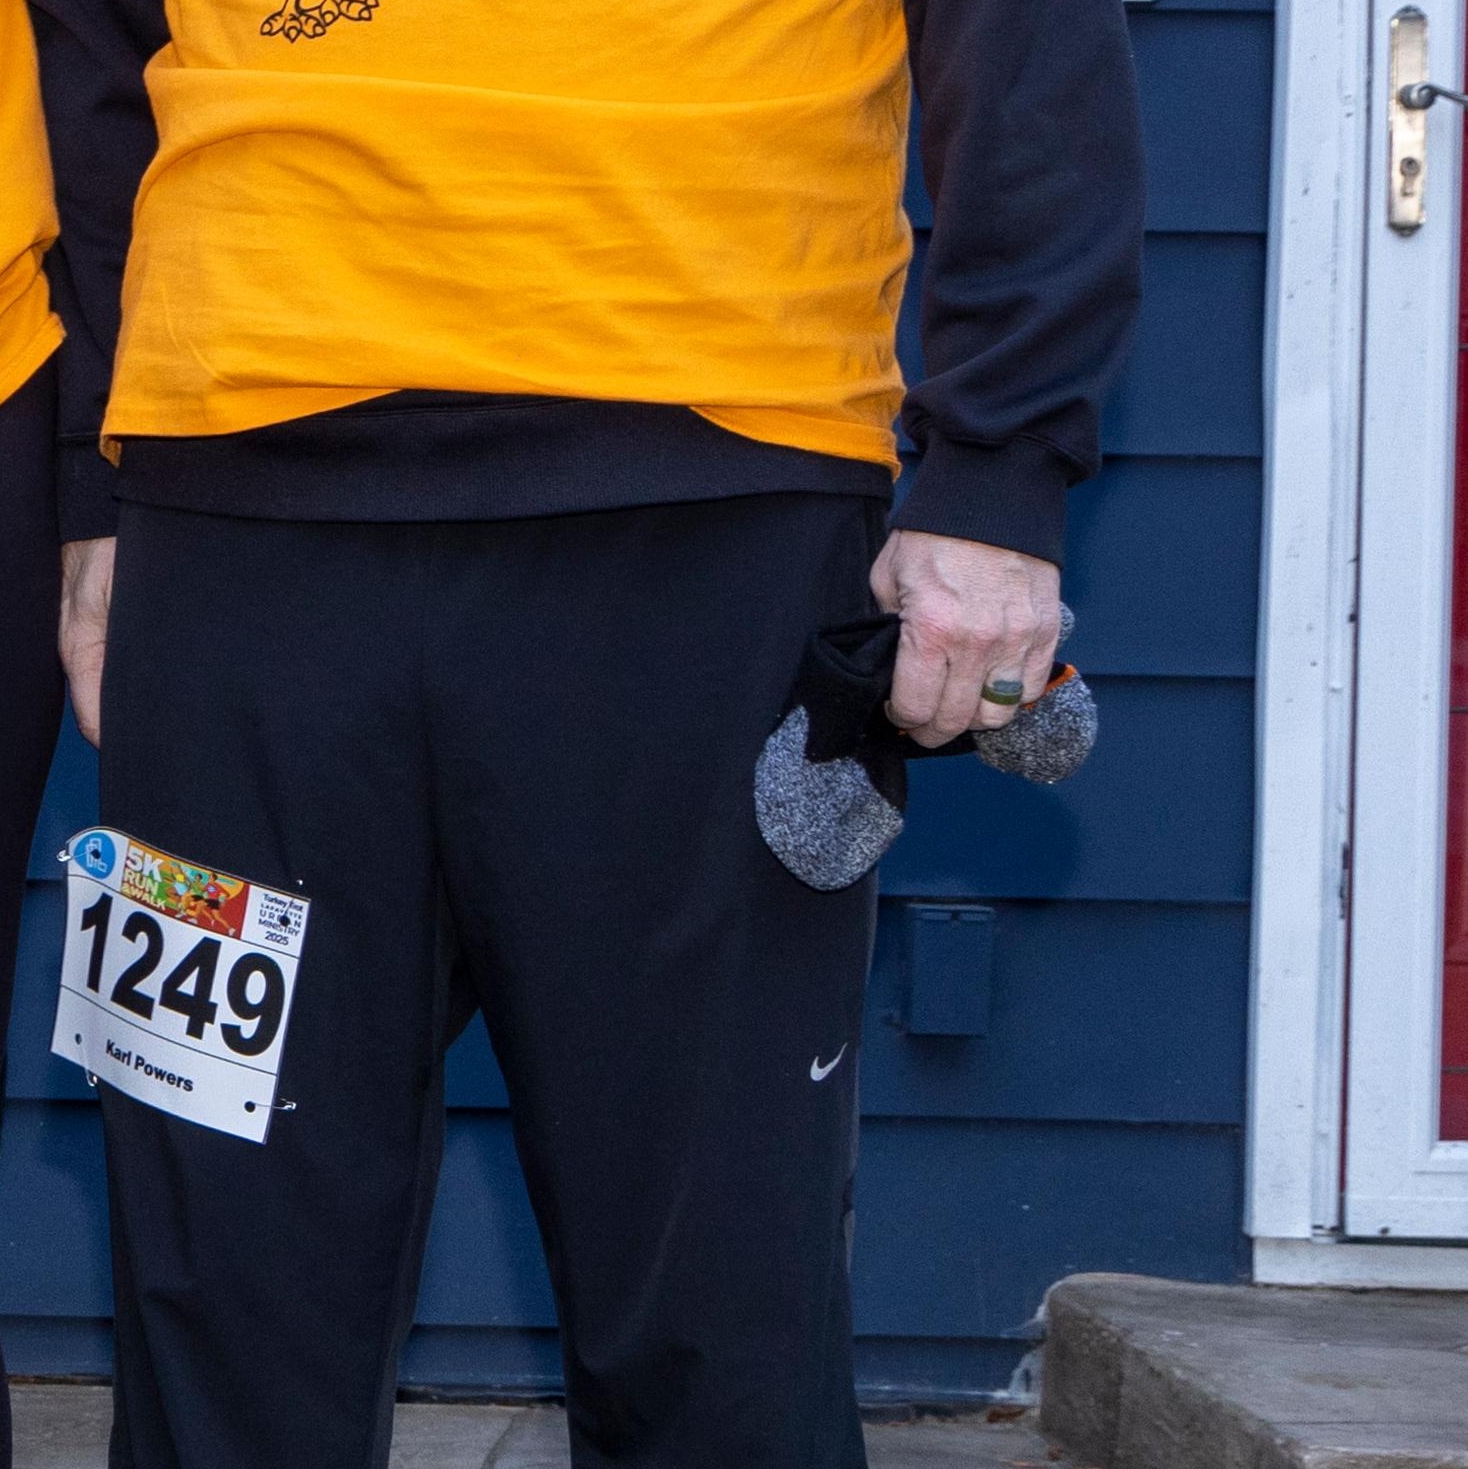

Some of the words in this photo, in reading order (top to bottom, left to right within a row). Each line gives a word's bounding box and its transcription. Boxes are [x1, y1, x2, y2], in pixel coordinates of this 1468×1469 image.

[123, 868, 159, 898] RUN
[126, 845, 164, 883] 5K
[265, 930, 290, 946] 2025
[80, 891, 286, 1057] 1249
[106, 1038, 132, 1067] Karl
[133, 1053, 194, 1092] Powers
